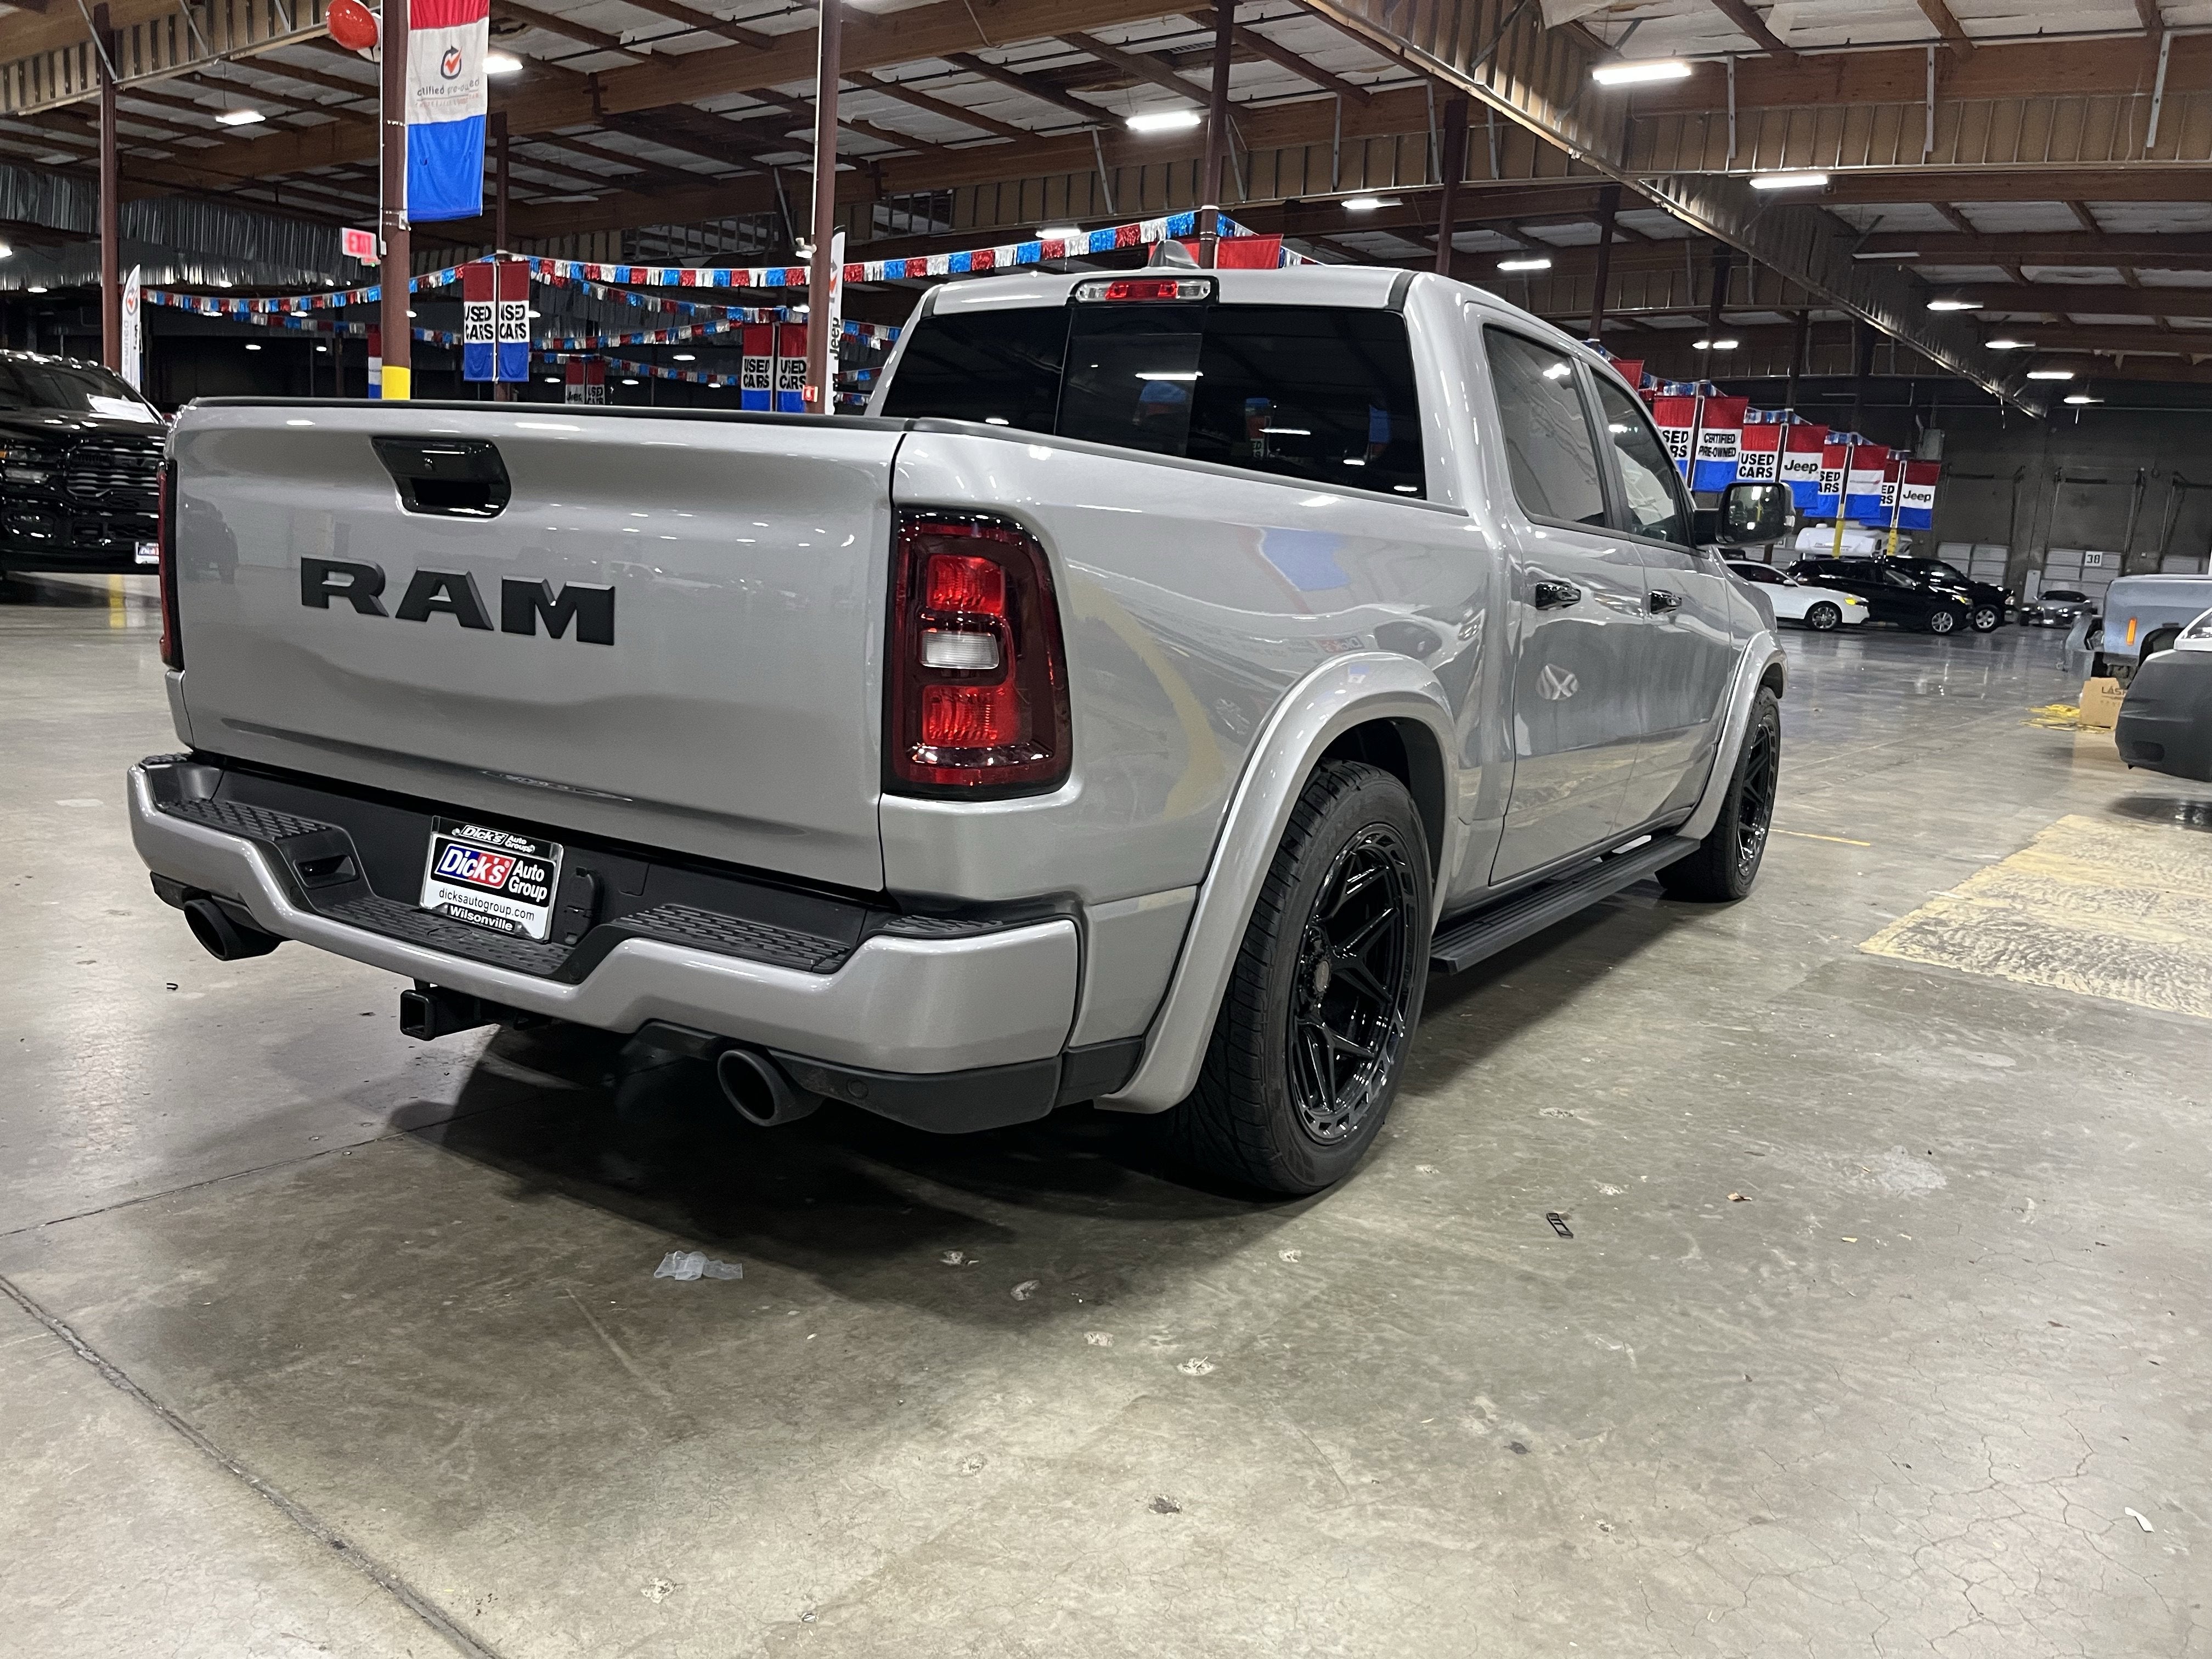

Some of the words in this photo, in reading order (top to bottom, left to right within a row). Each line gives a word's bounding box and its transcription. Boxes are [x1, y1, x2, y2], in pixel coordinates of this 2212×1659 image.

[1662, 430, 1689, 443] SED
[1704, 432, 1736, 444] CERTIFIED
[1670, 445, 1688, 458] RS
[1698, 445, 1736, 458] PRE-OWNED
[1741, 453, 1775, 466] USED
[1739, 466, 1773, 478] CARS
[1784, 460, 1819, 474] Jeep
[1819, 471, 1841, 482] SED
[1881, 484, 1895, 494] ED
[1881, 495, 1893, 504] RS
[1903, 490, 1932, 503] Jeep
[2086, 554, 2101, 564] 38
[301, 553, 616, 646] RAM
[462, 826, 505, 844] Dick's
[507, 835, 527, 845] Auto
[440, 848, 506, 884] Dick's
[512, 860, 545, 882] Auto
[508, 876, 548, 902] Group
[439, 888, 535, 921] dicksautogroup.com
[449, 905, 514, 931] Wilsonville
